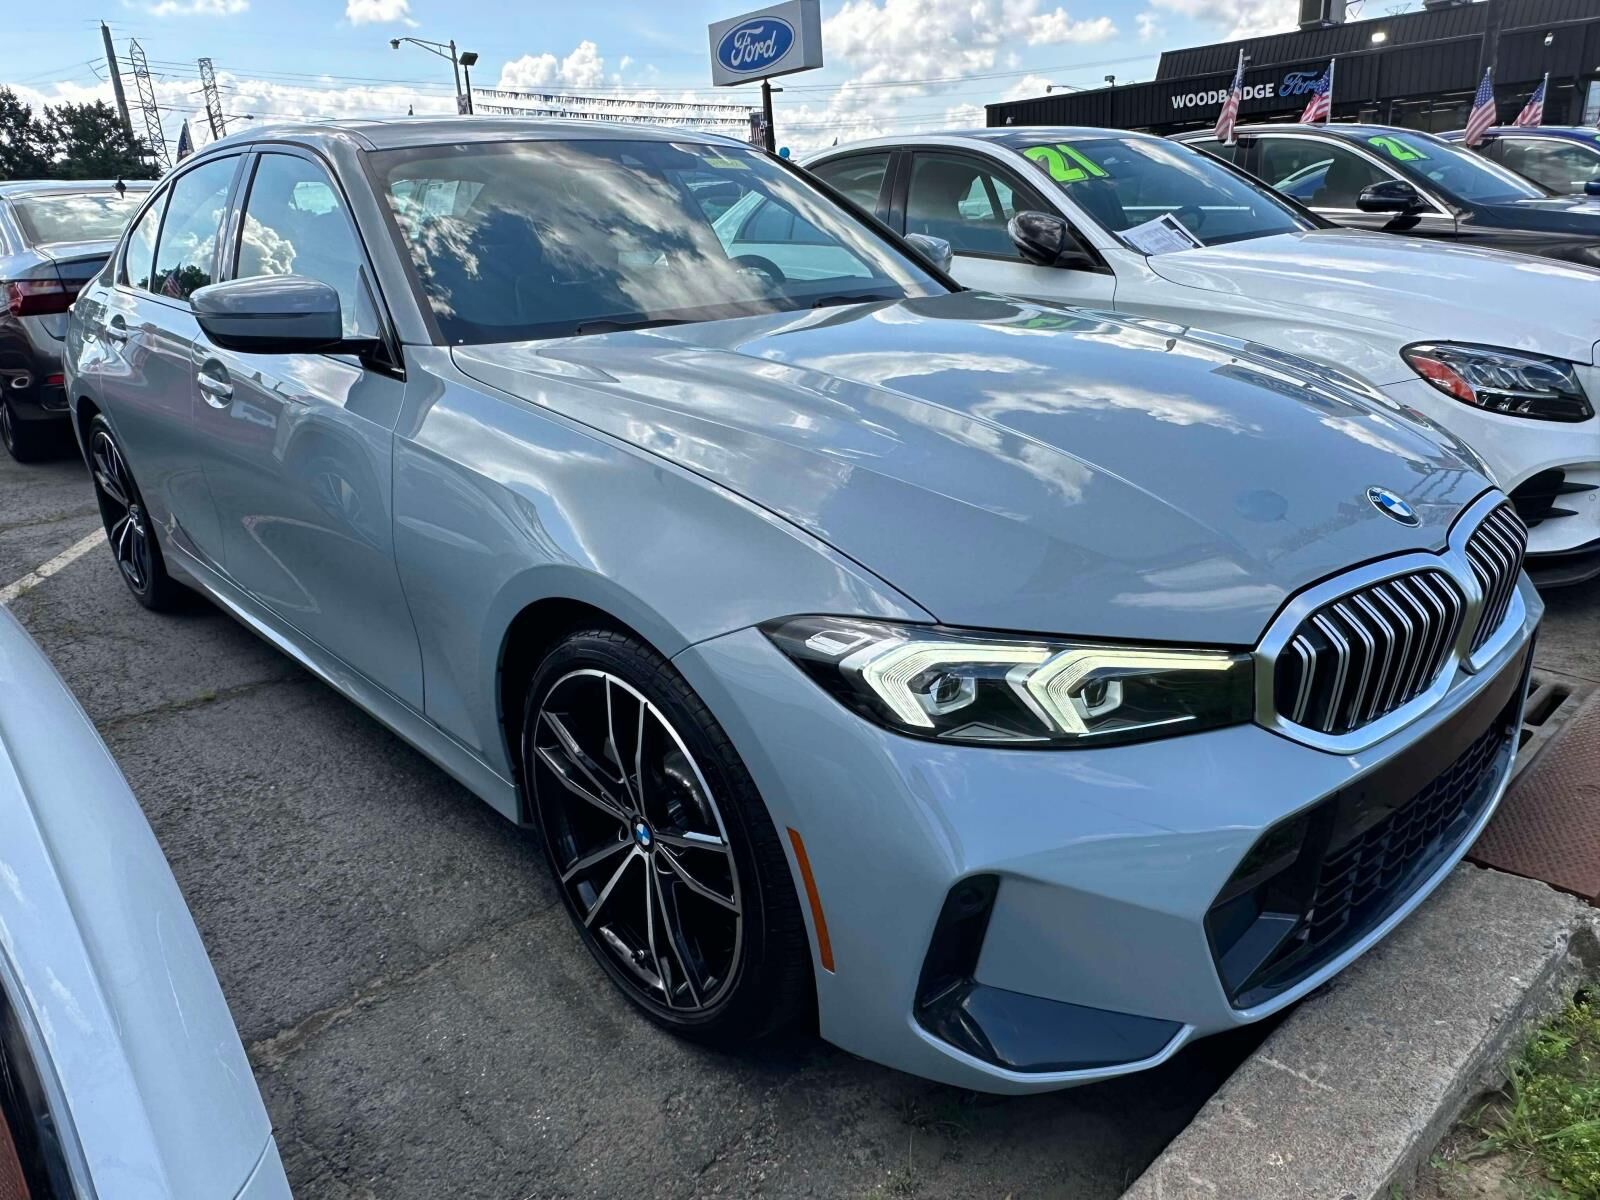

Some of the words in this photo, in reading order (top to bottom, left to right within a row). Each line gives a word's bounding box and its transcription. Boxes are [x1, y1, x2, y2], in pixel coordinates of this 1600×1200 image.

[731, 25, 777, 67] Ford
[1172, 83, 1274, 109] WOODBDGE
[1279, 71, 1319, 97] For
[1023, 144, 1109, 183] 21
[1368, 135, 1431, 161] 21
